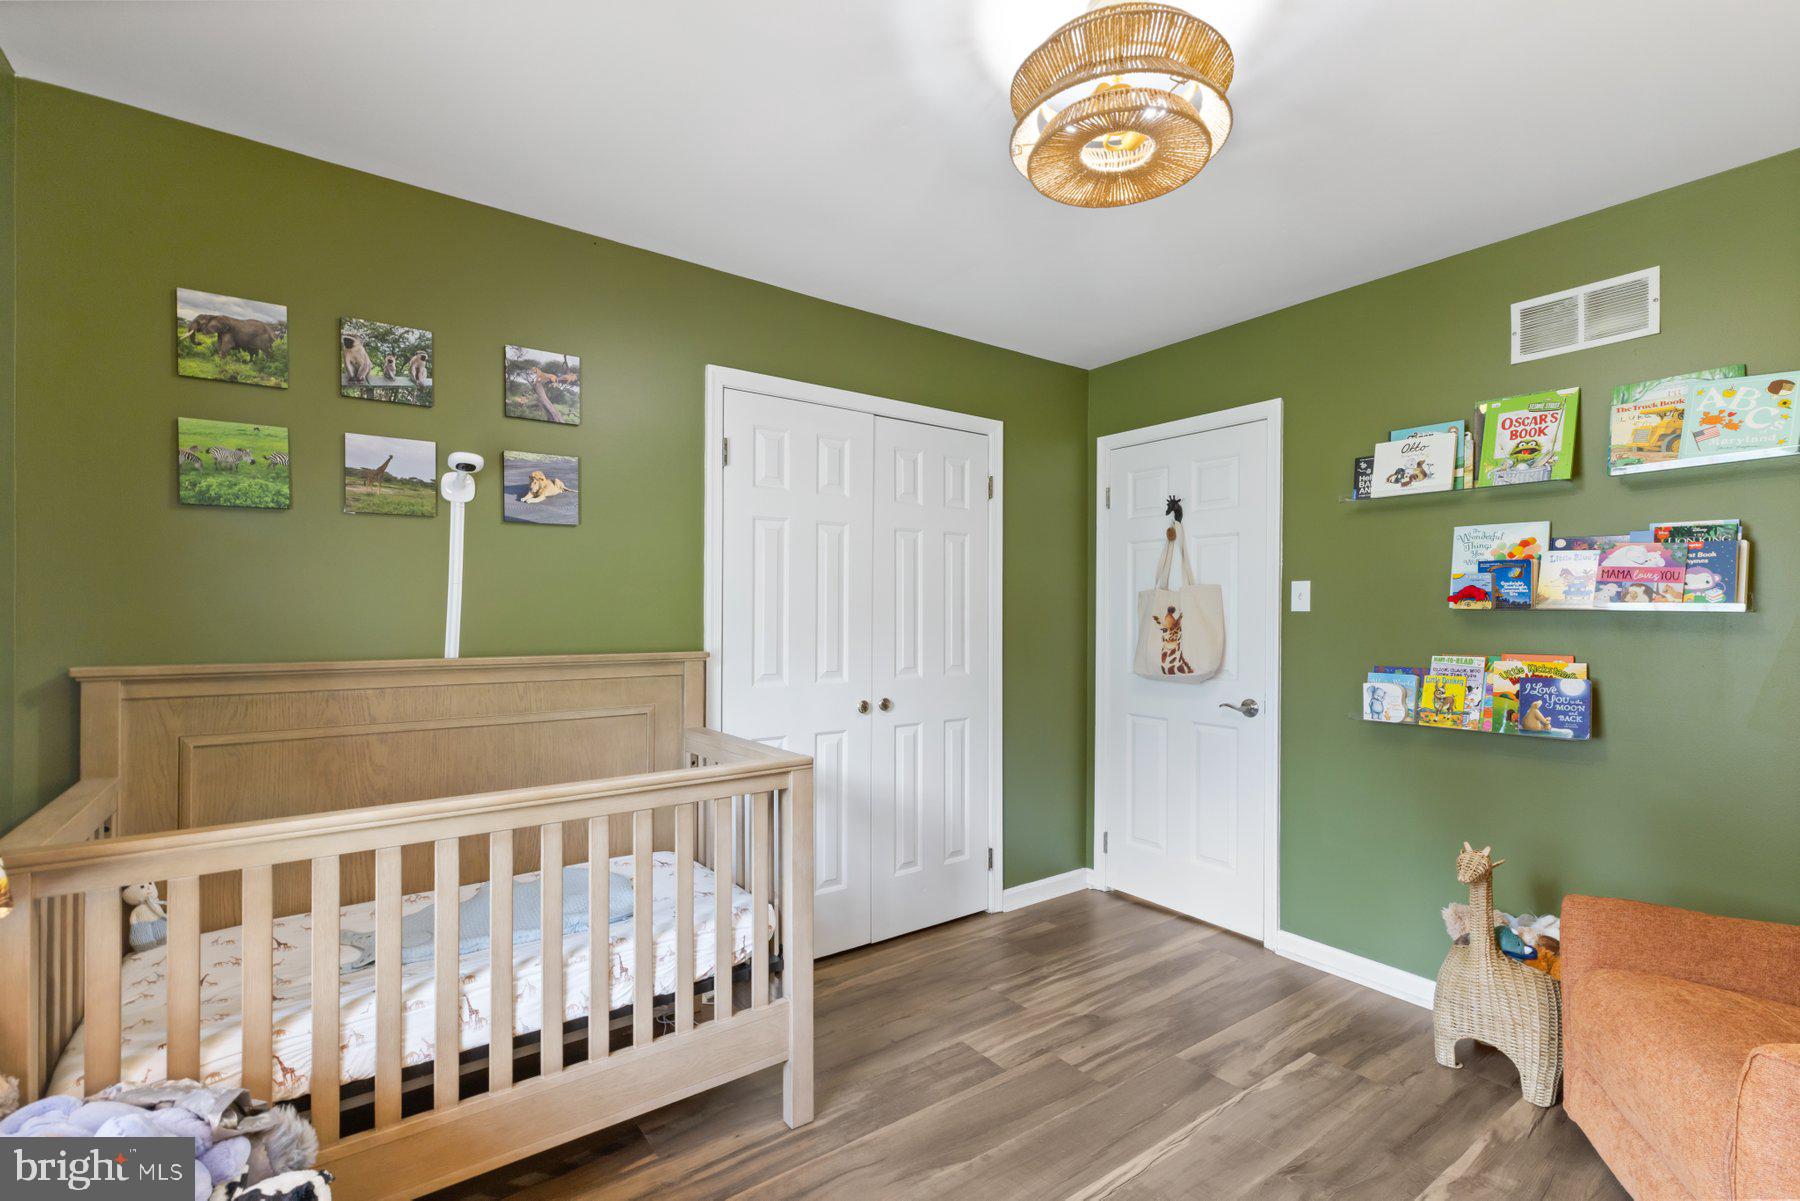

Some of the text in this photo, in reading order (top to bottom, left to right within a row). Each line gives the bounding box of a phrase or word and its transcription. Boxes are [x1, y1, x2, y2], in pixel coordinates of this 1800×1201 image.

[1633, 402, 1658, 411] Truck
[1660, 398, 1686, 407] Book
[1501, 412, 1559, 431] OSCAR'S
[1509, 426, 1549, 441] BOOK
[1401, 441, 1431, 454] Otto
[1456, 531, 1504, 543] Wonderful
[1463, 542, 1492, 552] Things
[1601, 569, 1681, 581] MAMA loves YOU
[1523, 682, 1559, 697] I Love
[1555, 704, 1586, 712] MOON
[1558, 715, 1584, 723] BACK
